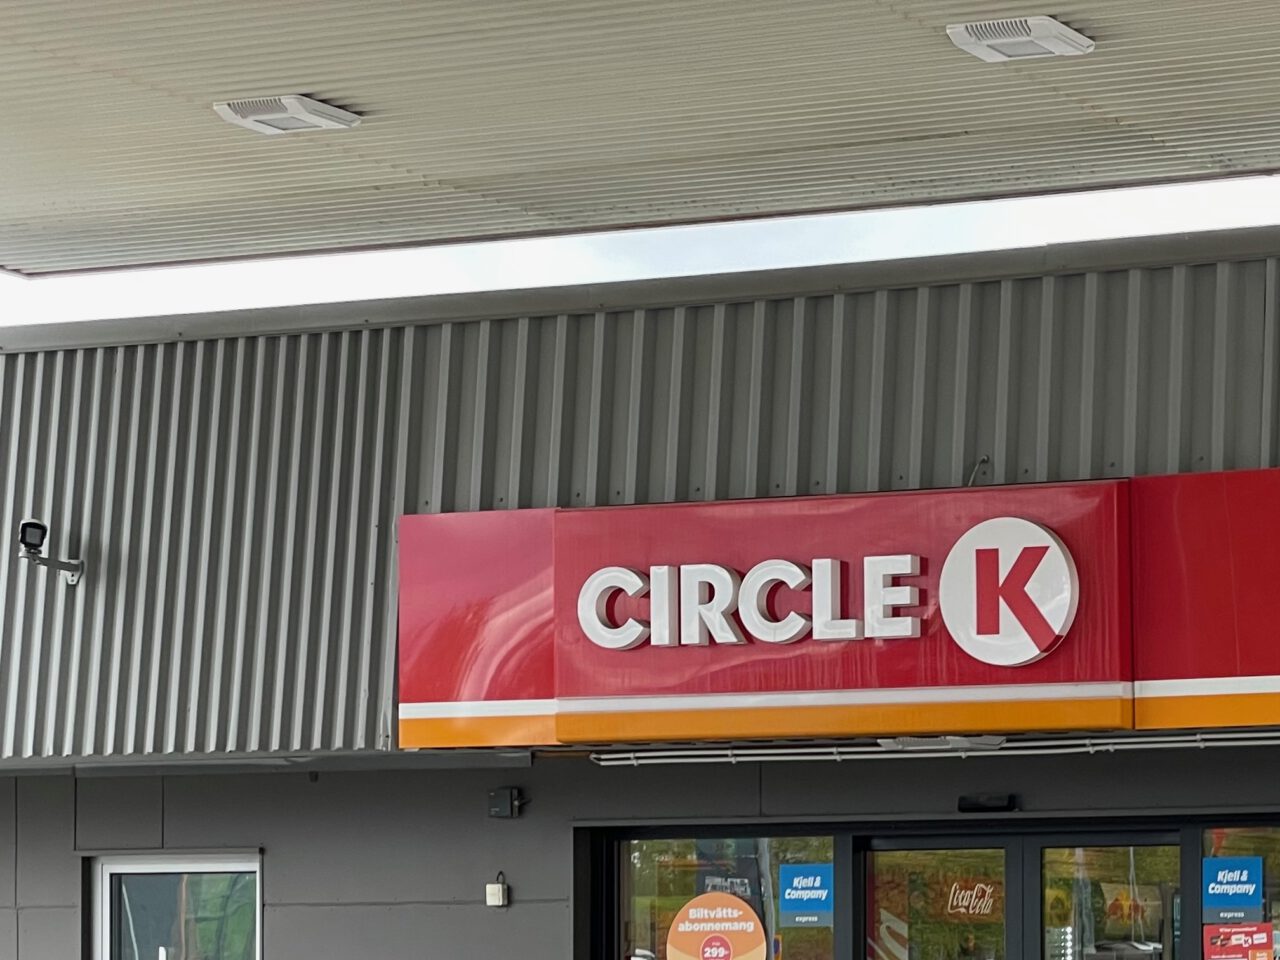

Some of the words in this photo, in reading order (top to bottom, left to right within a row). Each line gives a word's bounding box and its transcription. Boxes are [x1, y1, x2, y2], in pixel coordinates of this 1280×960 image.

[577, 553, 921, 650] CIRCLE
[968, 540, 1066, 656] K
[792, 876, 811, 888] Kjell
[812, 876, 821, 887] &
[1217, 870, 1240, 883] Kjell
[1240, 870, 1248, 881] &
[784, 888, 828, 900] Company
[1208, 882, 1256, 895] Company
[688, 906, 743, 920] Biltvätts-
[1220, 911, 1244, 919] express
[677, 919, 755, 932] abonnemang
